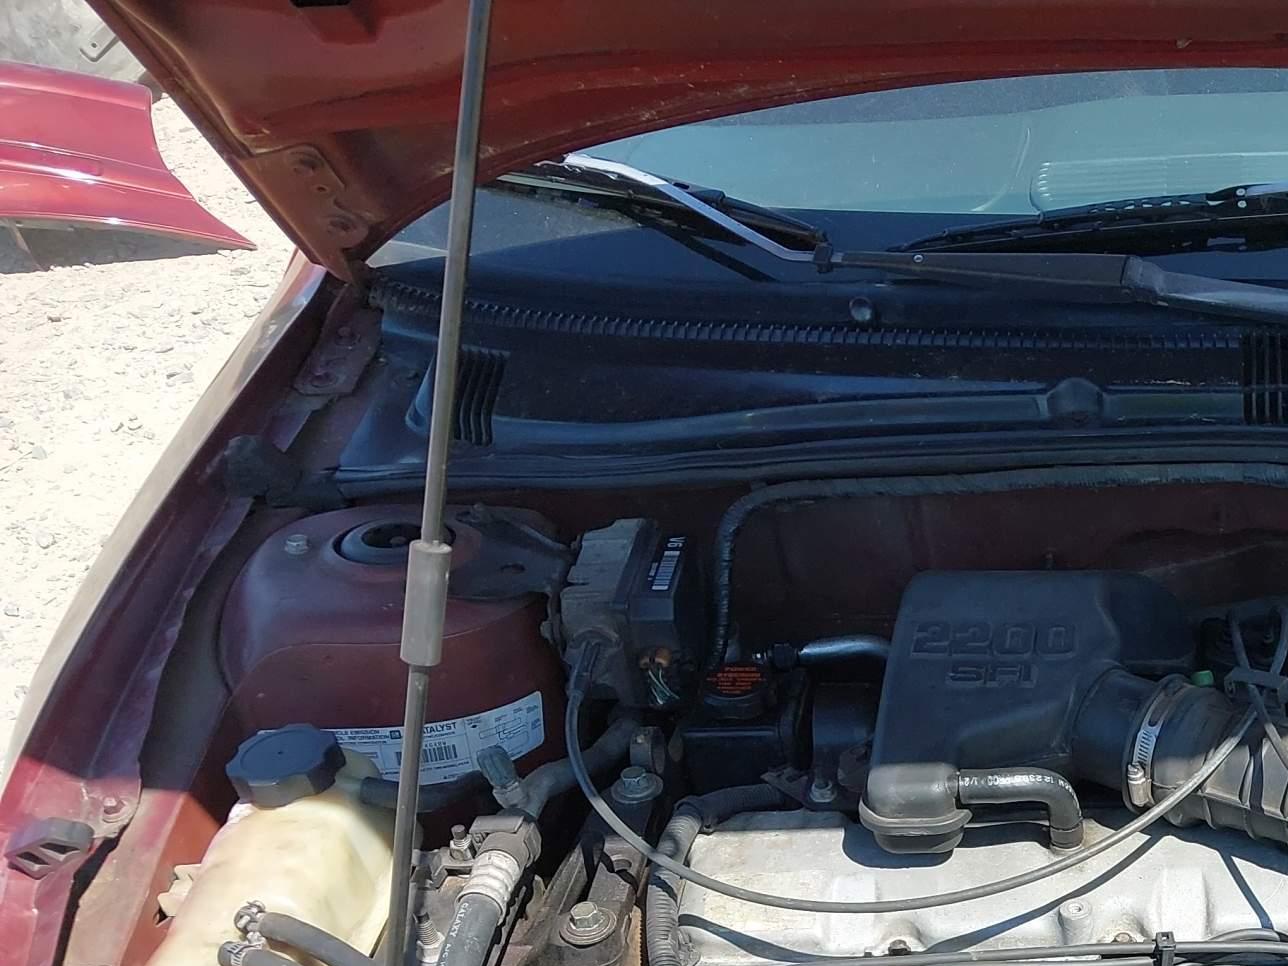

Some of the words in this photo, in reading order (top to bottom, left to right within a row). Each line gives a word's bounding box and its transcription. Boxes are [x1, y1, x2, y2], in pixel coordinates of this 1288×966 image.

[667, 536, 687, 548] V6
[910, 620, 1079, 660] 2200
[945, 663, 1039, 689] SFI
[423, 722, 457, 735] ATALYST
[449, 902, 469, 938] GALAXY
